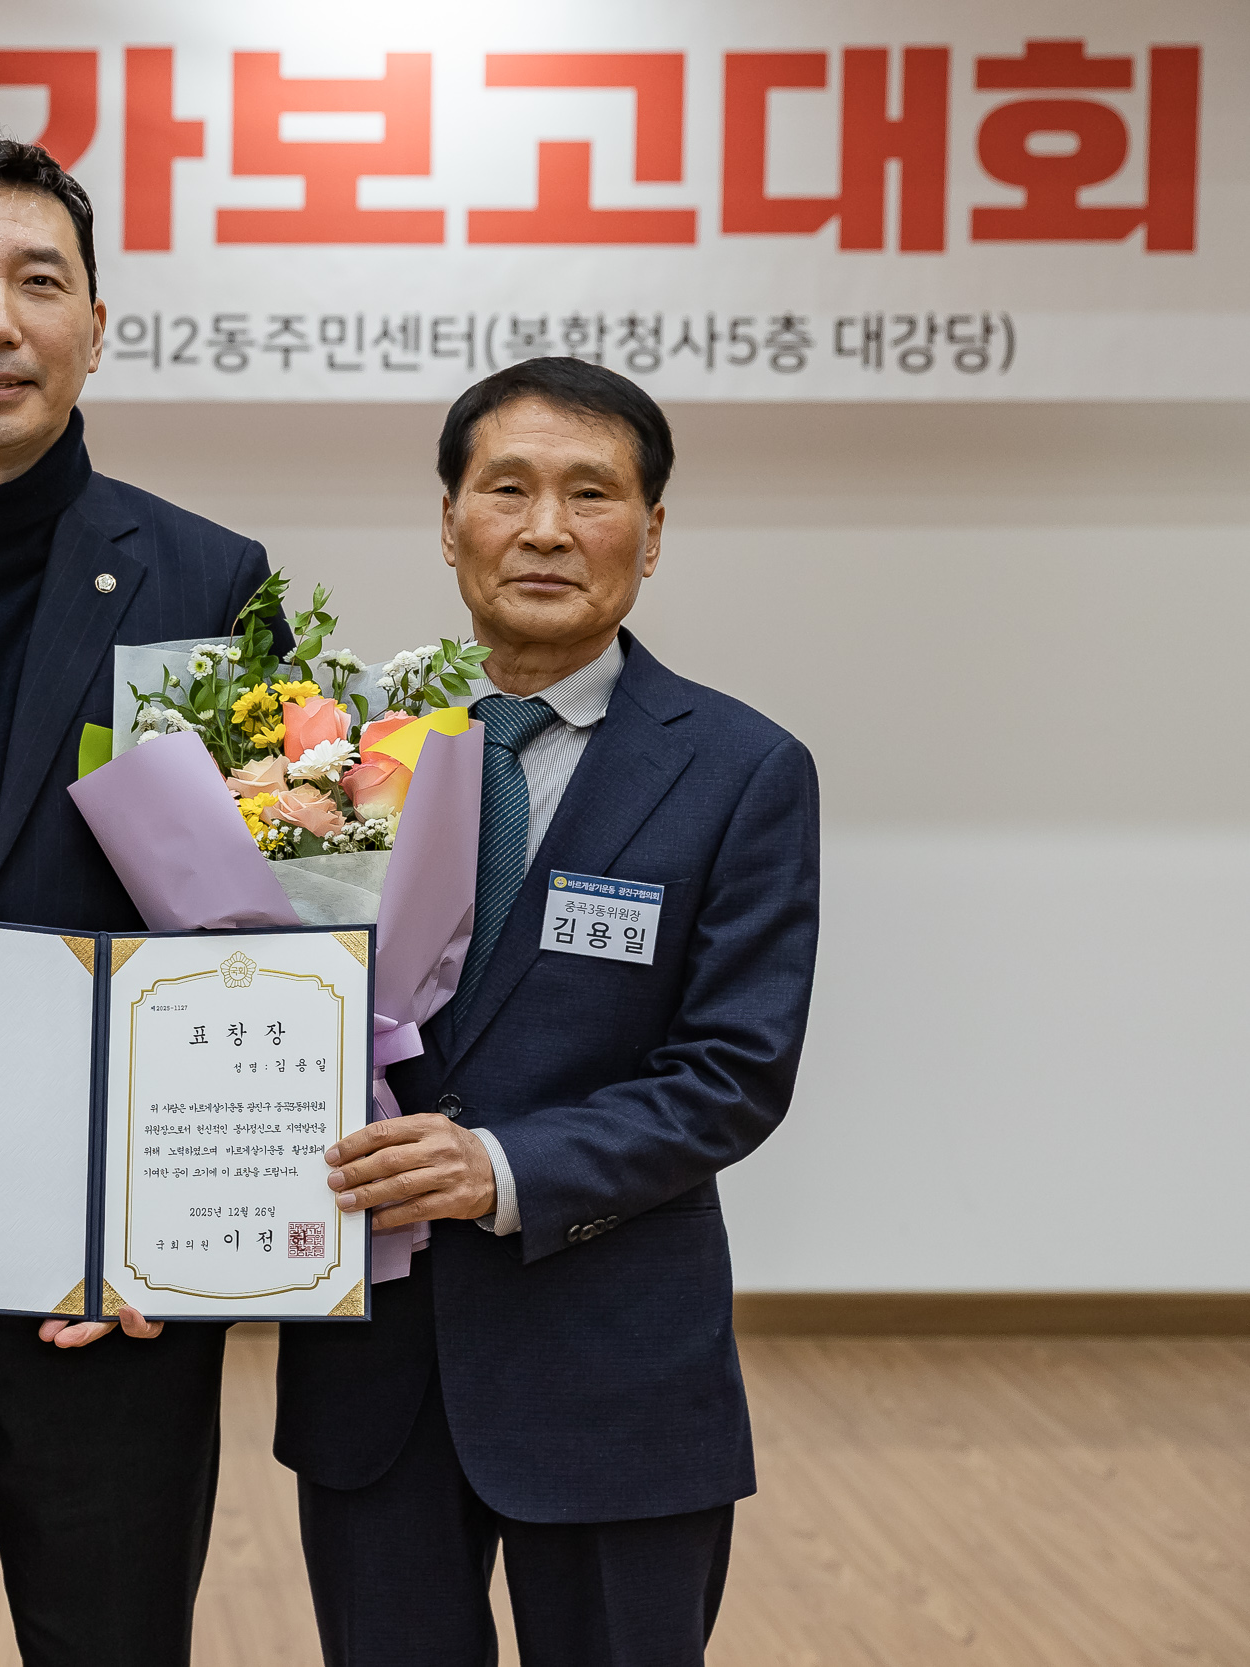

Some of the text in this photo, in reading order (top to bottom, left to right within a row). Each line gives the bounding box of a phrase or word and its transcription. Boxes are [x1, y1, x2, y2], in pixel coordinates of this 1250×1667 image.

[102, 310, 1018, 375] 의2동주민센터(복합청사5층 대강당)
[568, 879, 661, 901] 바르게살기운동 광진구협의회
[565, 900, 641, 923] 중곡3동위원장
[230, 966, 246, 976] 국회
[150, 1103, 159, 1114] 위
[162, 1102, 186, 1114] 사람은
[189, 1101, 244, 1114] 바르게살기운동
[247, 1101, 271, 1113] 광진구
[144, 1122, 327, 1135] 위원장으로서 헌신적인 봉사정신으로 지역발전을
[144, 1144, 325, 1156] 위해 노력하였으며 바르게살기운동 활성화에
[144, 1166, 299, 1178] 기여한 공이 크기에 이 표창을 드립니다.
[189, 1205, 276, 1218] 2025년 12월 26일
